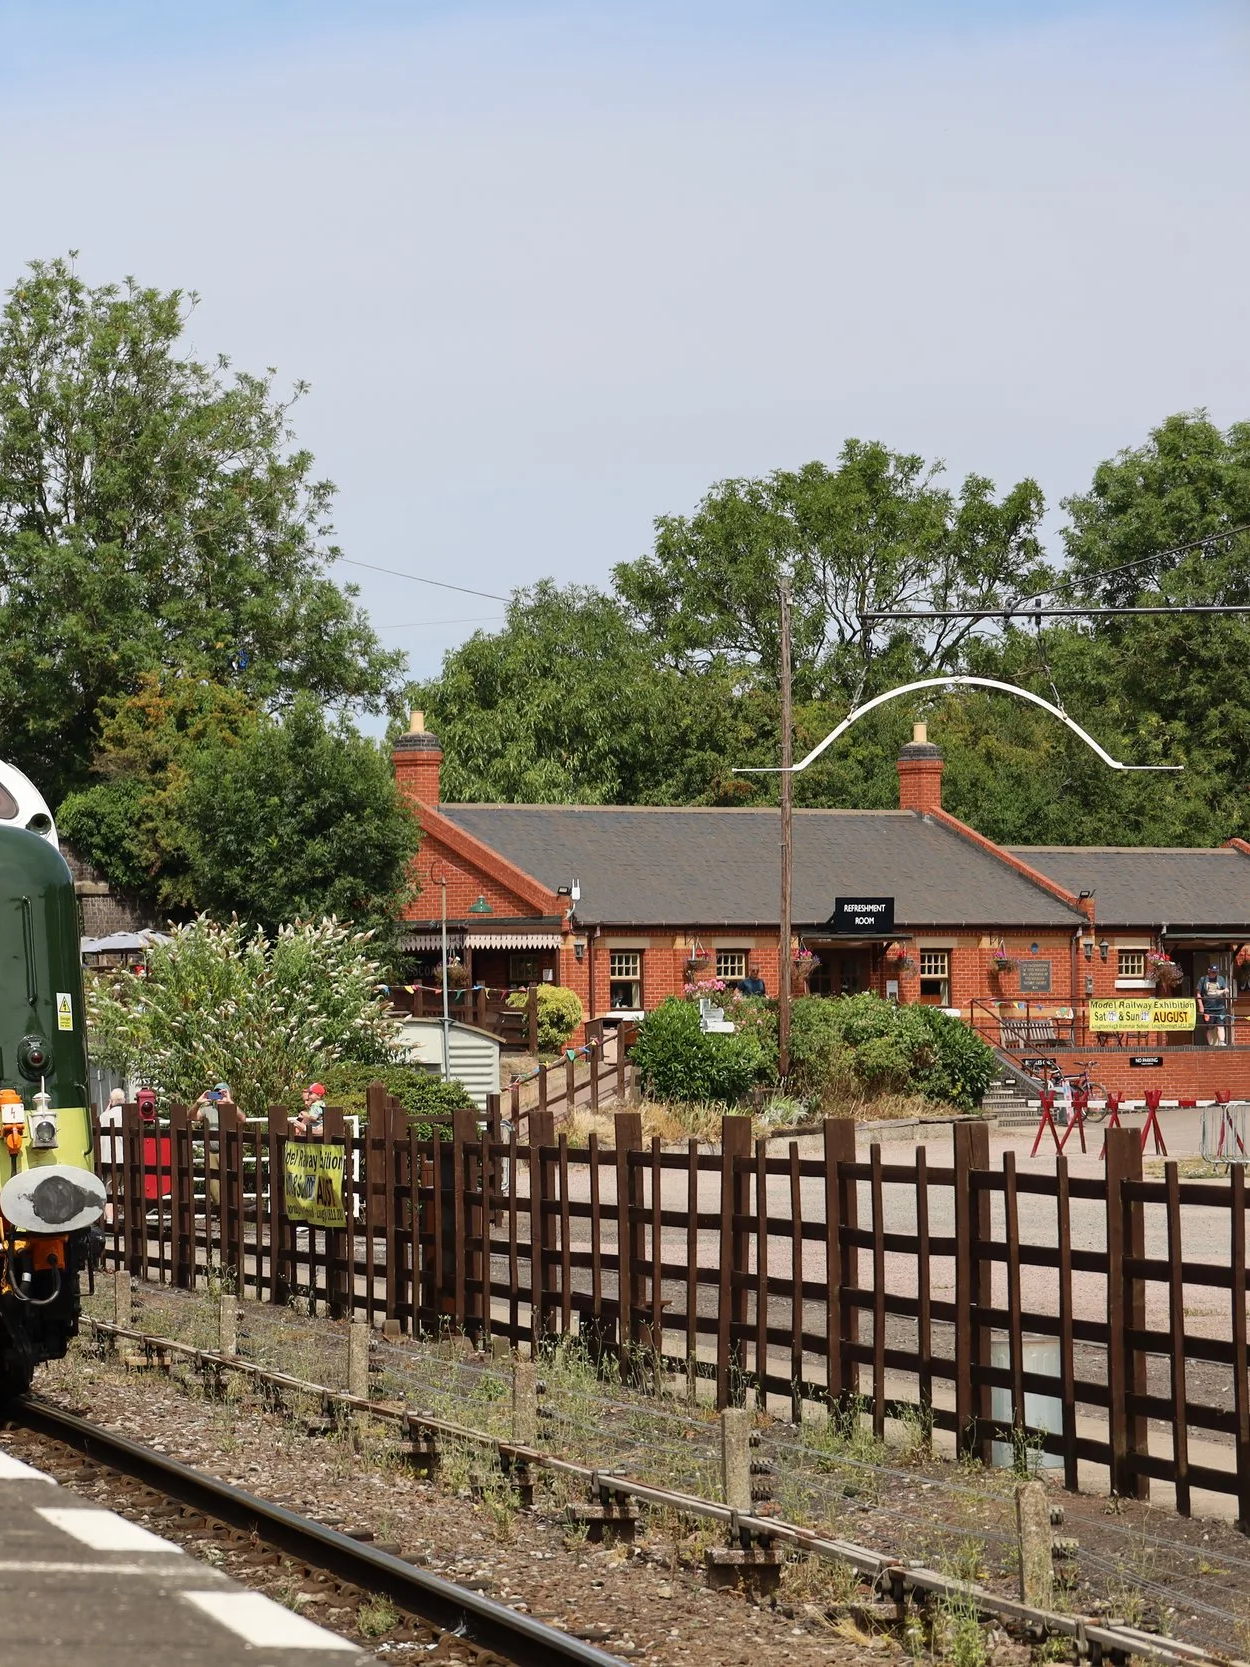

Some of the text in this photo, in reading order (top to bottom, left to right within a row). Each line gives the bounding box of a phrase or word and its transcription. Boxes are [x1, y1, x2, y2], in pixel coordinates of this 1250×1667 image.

[843, 904, 886, 913] REFRESHMENT
[854, 916, 875, 925] ROOM
[1090, 1000, 1195, 1010] Model Railway Exhibition
[1094, 1011, 1106, 1021] Sat
[1118, 1011, 1124, 1021] &
[1125, 1011, 1140, 1021] Sun
[1153, 1011, 1188, 1023] AUGUST
